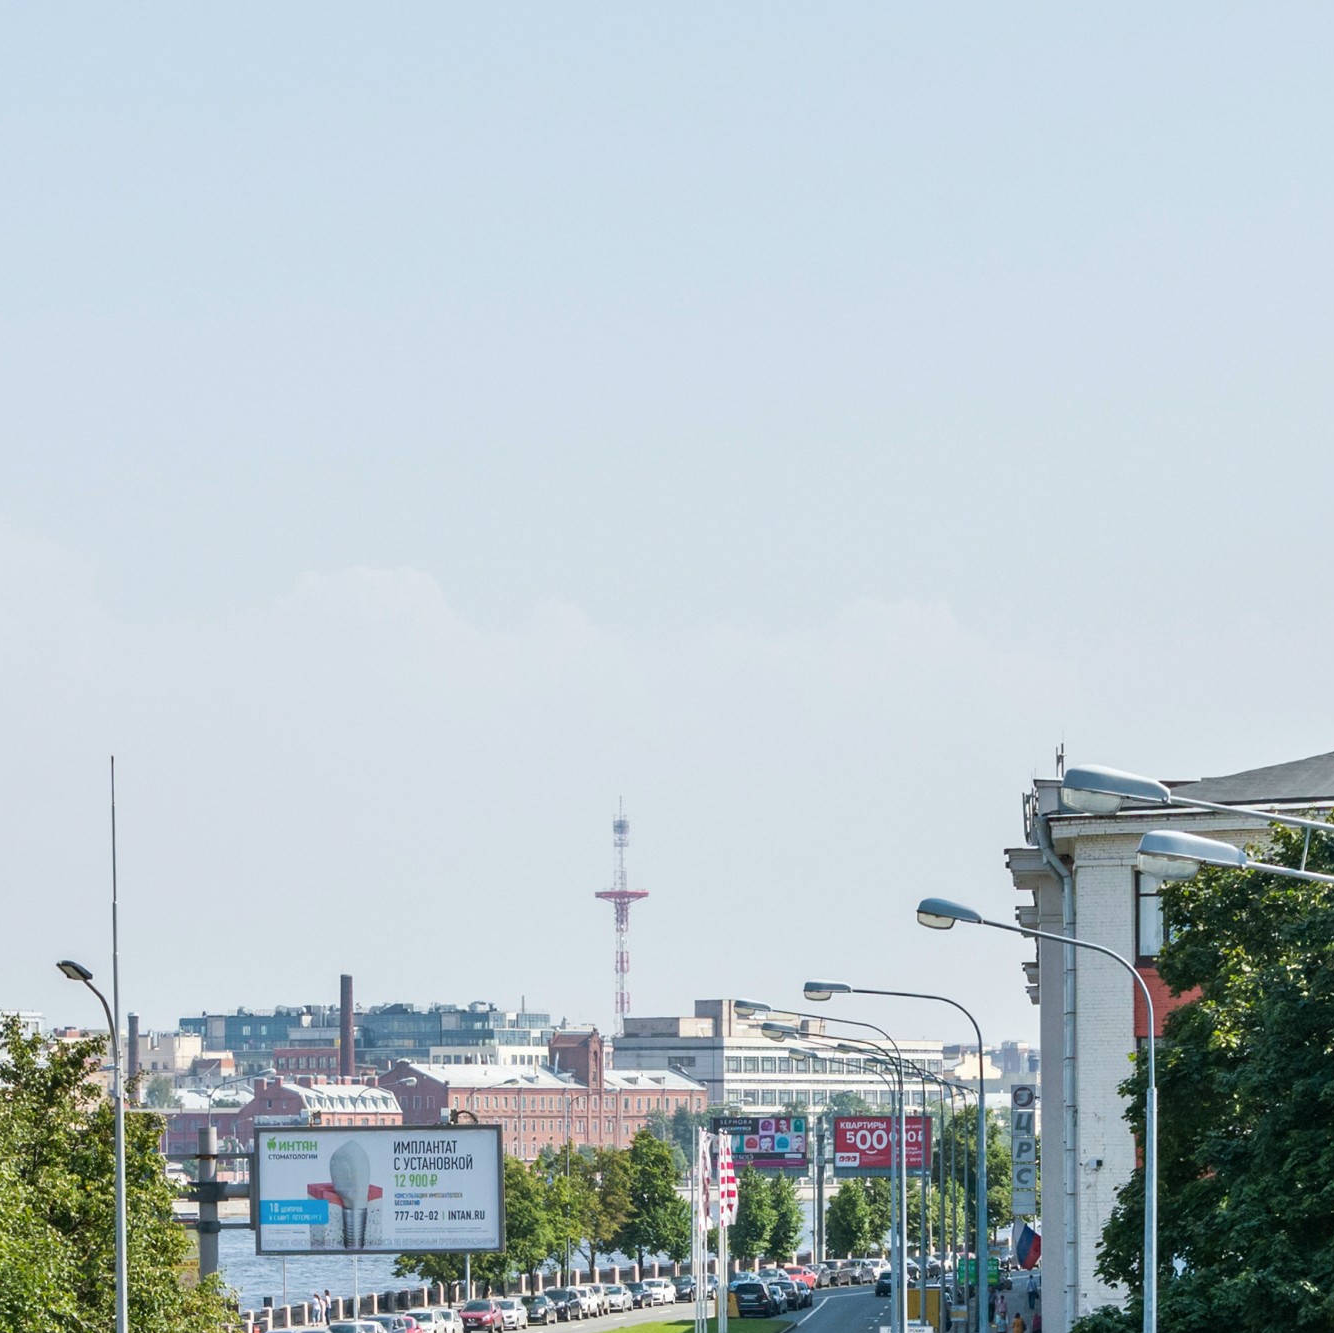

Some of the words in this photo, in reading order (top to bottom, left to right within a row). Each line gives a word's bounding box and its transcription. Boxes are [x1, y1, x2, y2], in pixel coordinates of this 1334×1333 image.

[840, 1121, 886, 1129] КВАРТИРЫ
[278, 1140, 318, 1151] ИНТАН
[846, 1129, 888, 1150] 500
[393, 1140, 457, 1154] ИМПЛАНТАТ
[393, 1157, 400, 1170] С
[404, 1154, 473, 1170] УСТАНОВКОЙ
[394, 1174, 406, 1187] 12
[269, 1203, 279, 1213] 18
[394, 1211, 439, 1220] 777-02-02
[448, 1210, 486, 1220] INTAN.RU
